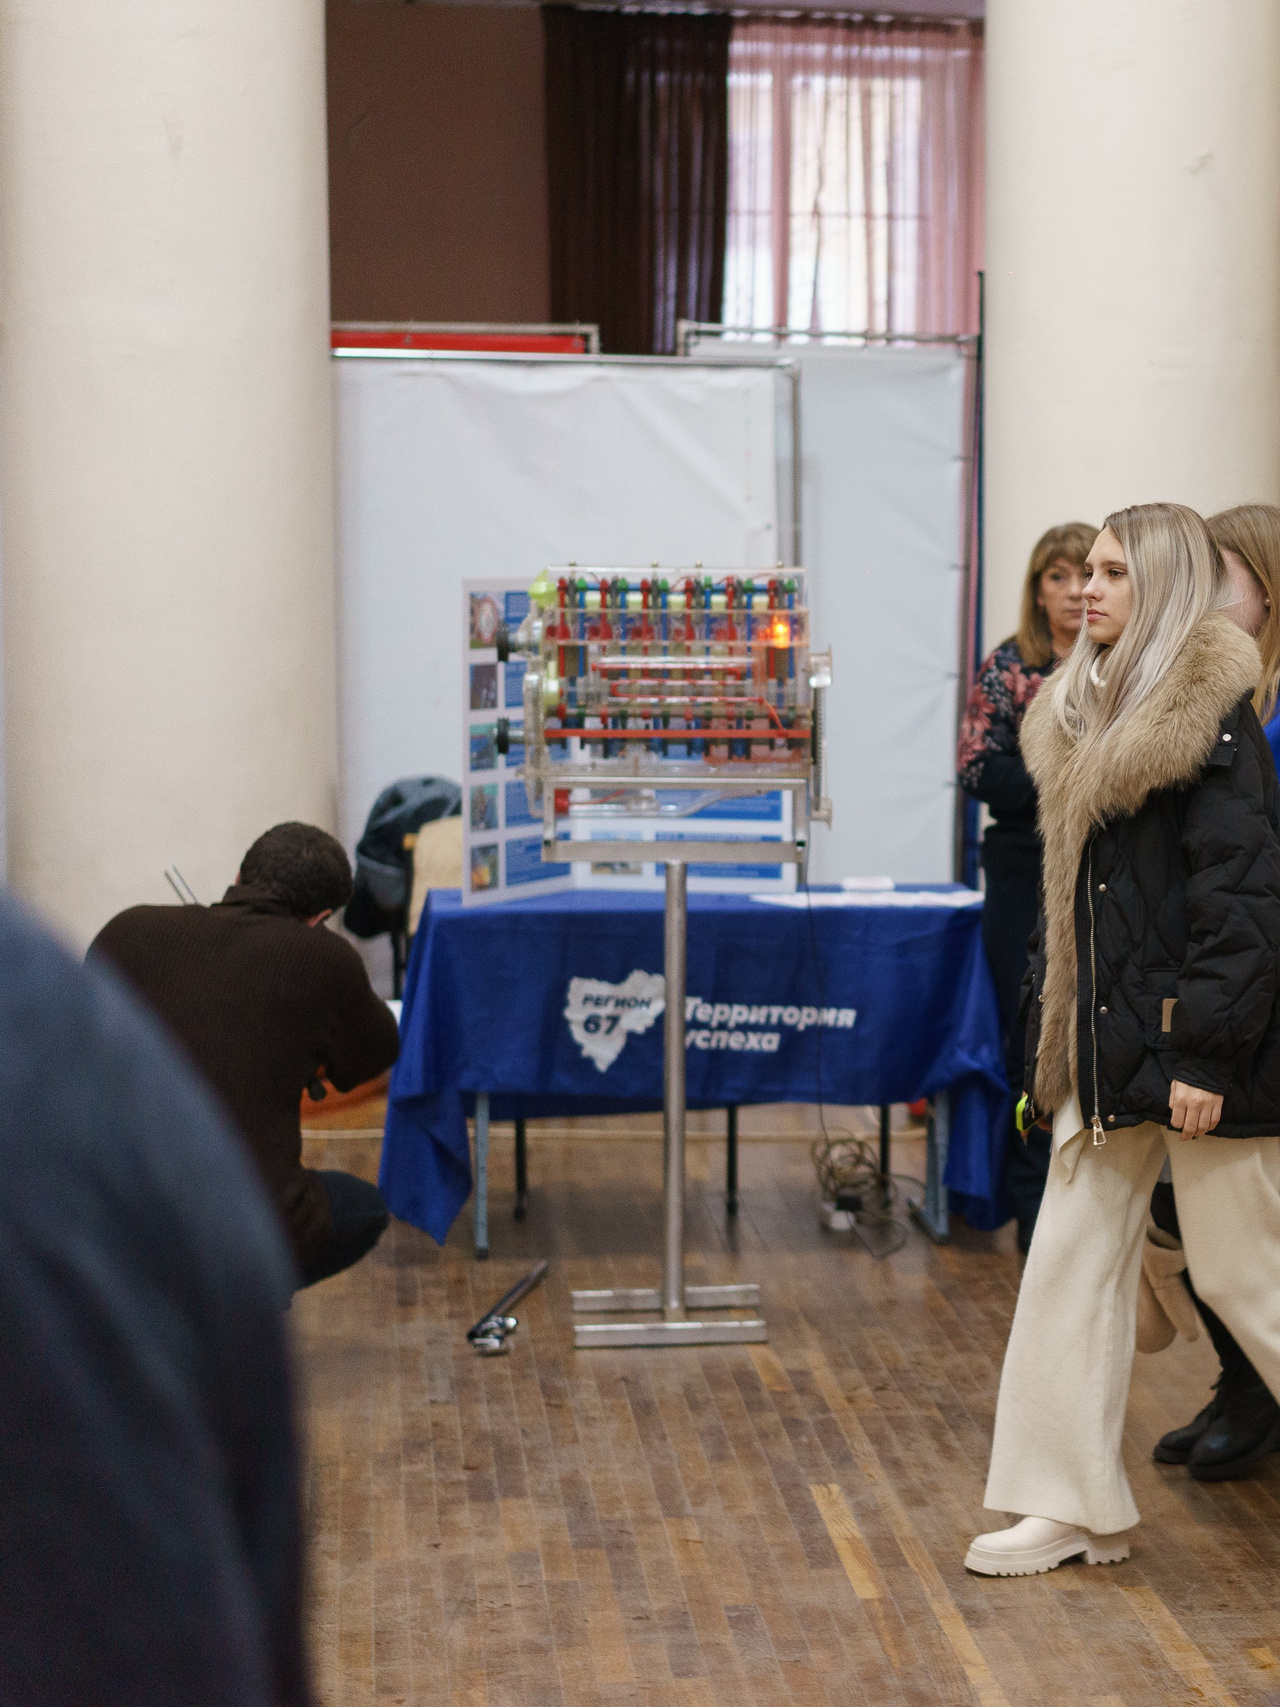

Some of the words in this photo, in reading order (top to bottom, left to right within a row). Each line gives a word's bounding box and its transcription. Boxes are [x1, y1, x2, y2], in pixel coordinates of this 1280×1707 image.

[582, 994, 652, 1009] РЕГИОН
[685, 996, 857, 1031] Территория
[584, 1014, 620, 1034] 67
